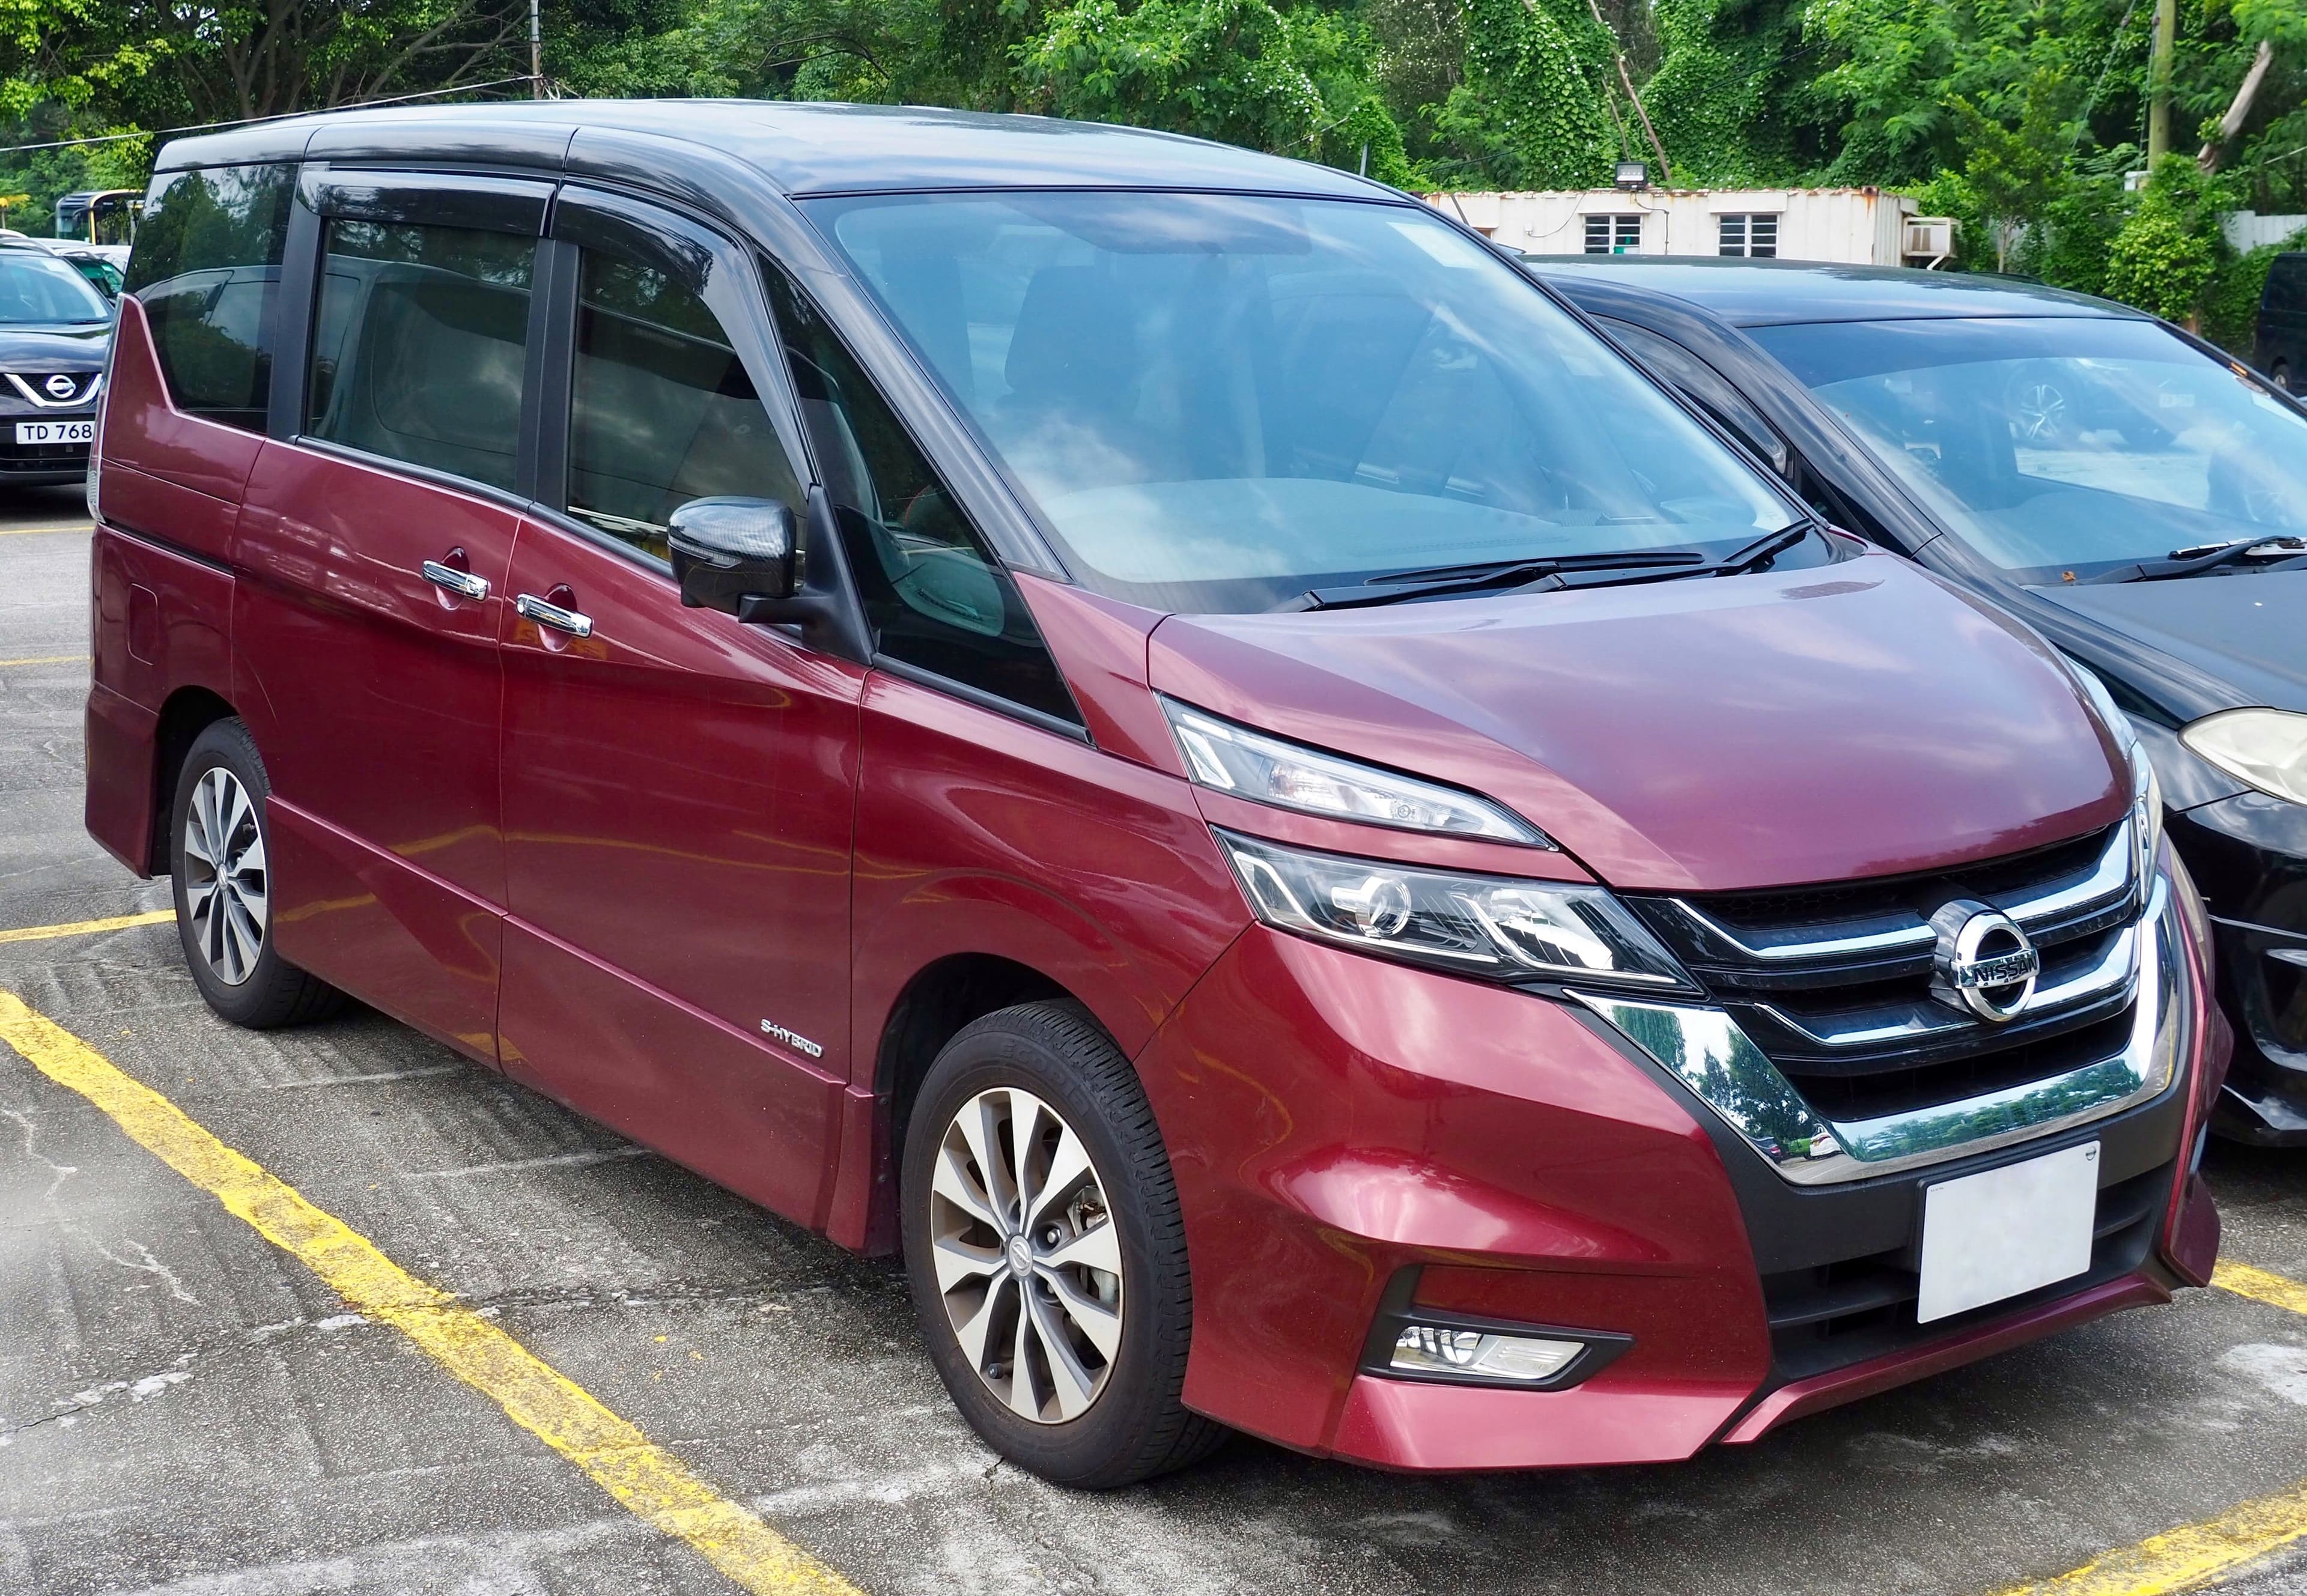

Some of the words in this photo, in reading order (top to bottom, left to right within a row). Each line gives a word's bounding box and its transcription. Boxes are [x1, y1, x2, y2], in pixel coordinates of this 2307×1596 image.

[24, 425, 48, 440] TD
[56, 424, 92, 439] 768
[1974, 956, 2037, 982] NISSAN
[761, 1018, 822, 1058] S-HYBRID
